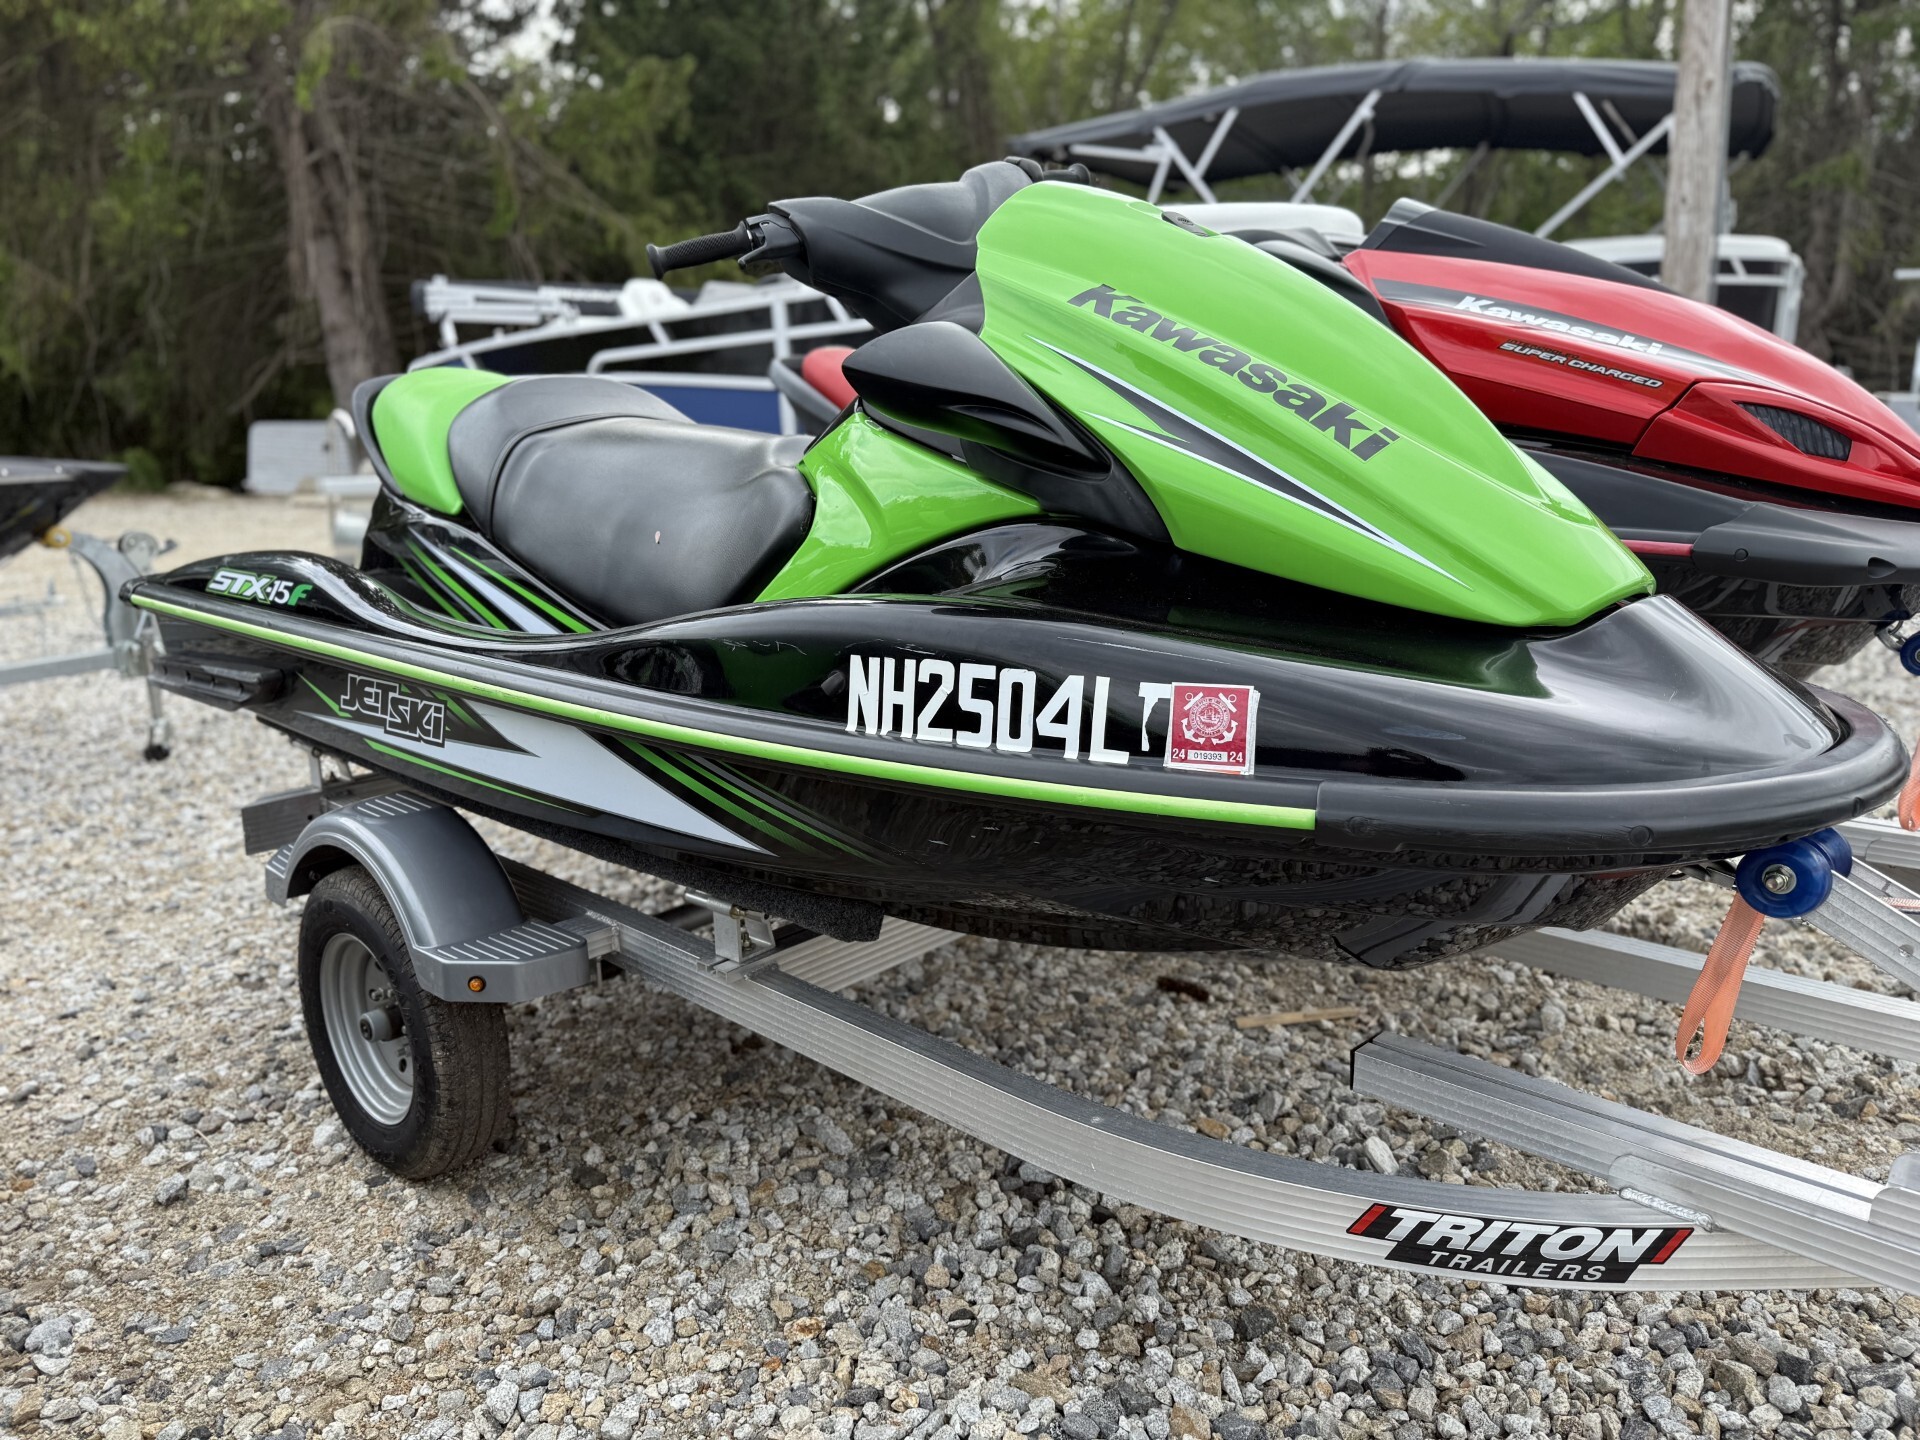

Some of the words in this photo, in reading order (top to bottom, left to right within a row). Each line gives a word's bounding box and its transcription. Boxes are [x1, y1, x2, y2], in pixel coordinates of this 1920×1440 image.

[1454, 296, 1663, 355] Kawasaki
[1067, 284, 1400, 462] Kawasaki
[1500, 342, 1566, 364] SUPER
[1568, 359, 1663, 388] CHARGED
[1172, 748, 1186, 760] 24
[1193, 752, 1222, 761] 019393
[1229, 751, 1243, 763] 24
[1385, 1208, 1664, 1263] TRITON
[1429, 1250, 1606, 1281] TRAILERS
